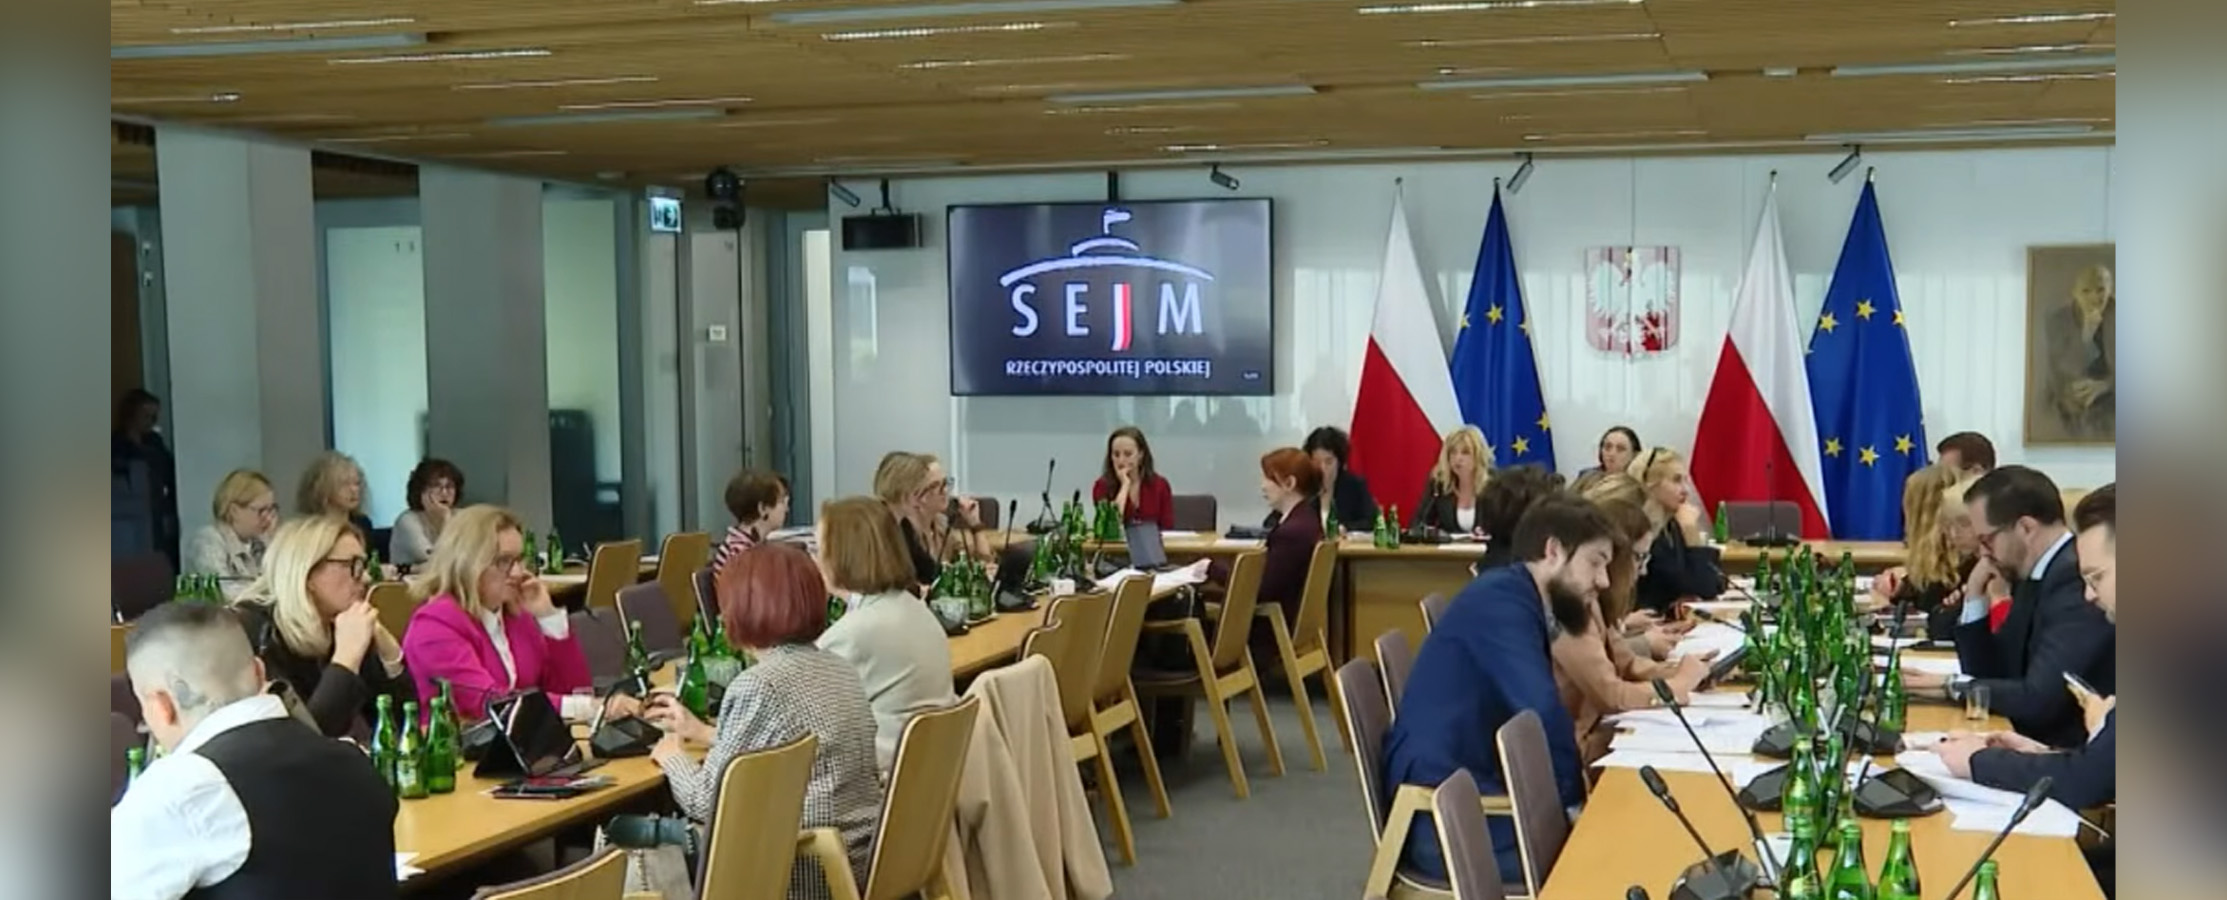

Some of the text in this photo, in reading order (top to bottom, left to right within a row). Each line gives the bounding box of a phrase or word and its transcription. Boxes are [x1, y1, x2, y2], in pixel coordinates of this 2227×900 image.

[1012, 283, 1203, 351] SEJM
[1006, 361, 1211, 378] RZECZYPOSPOLITEJ POLSKIEJ
